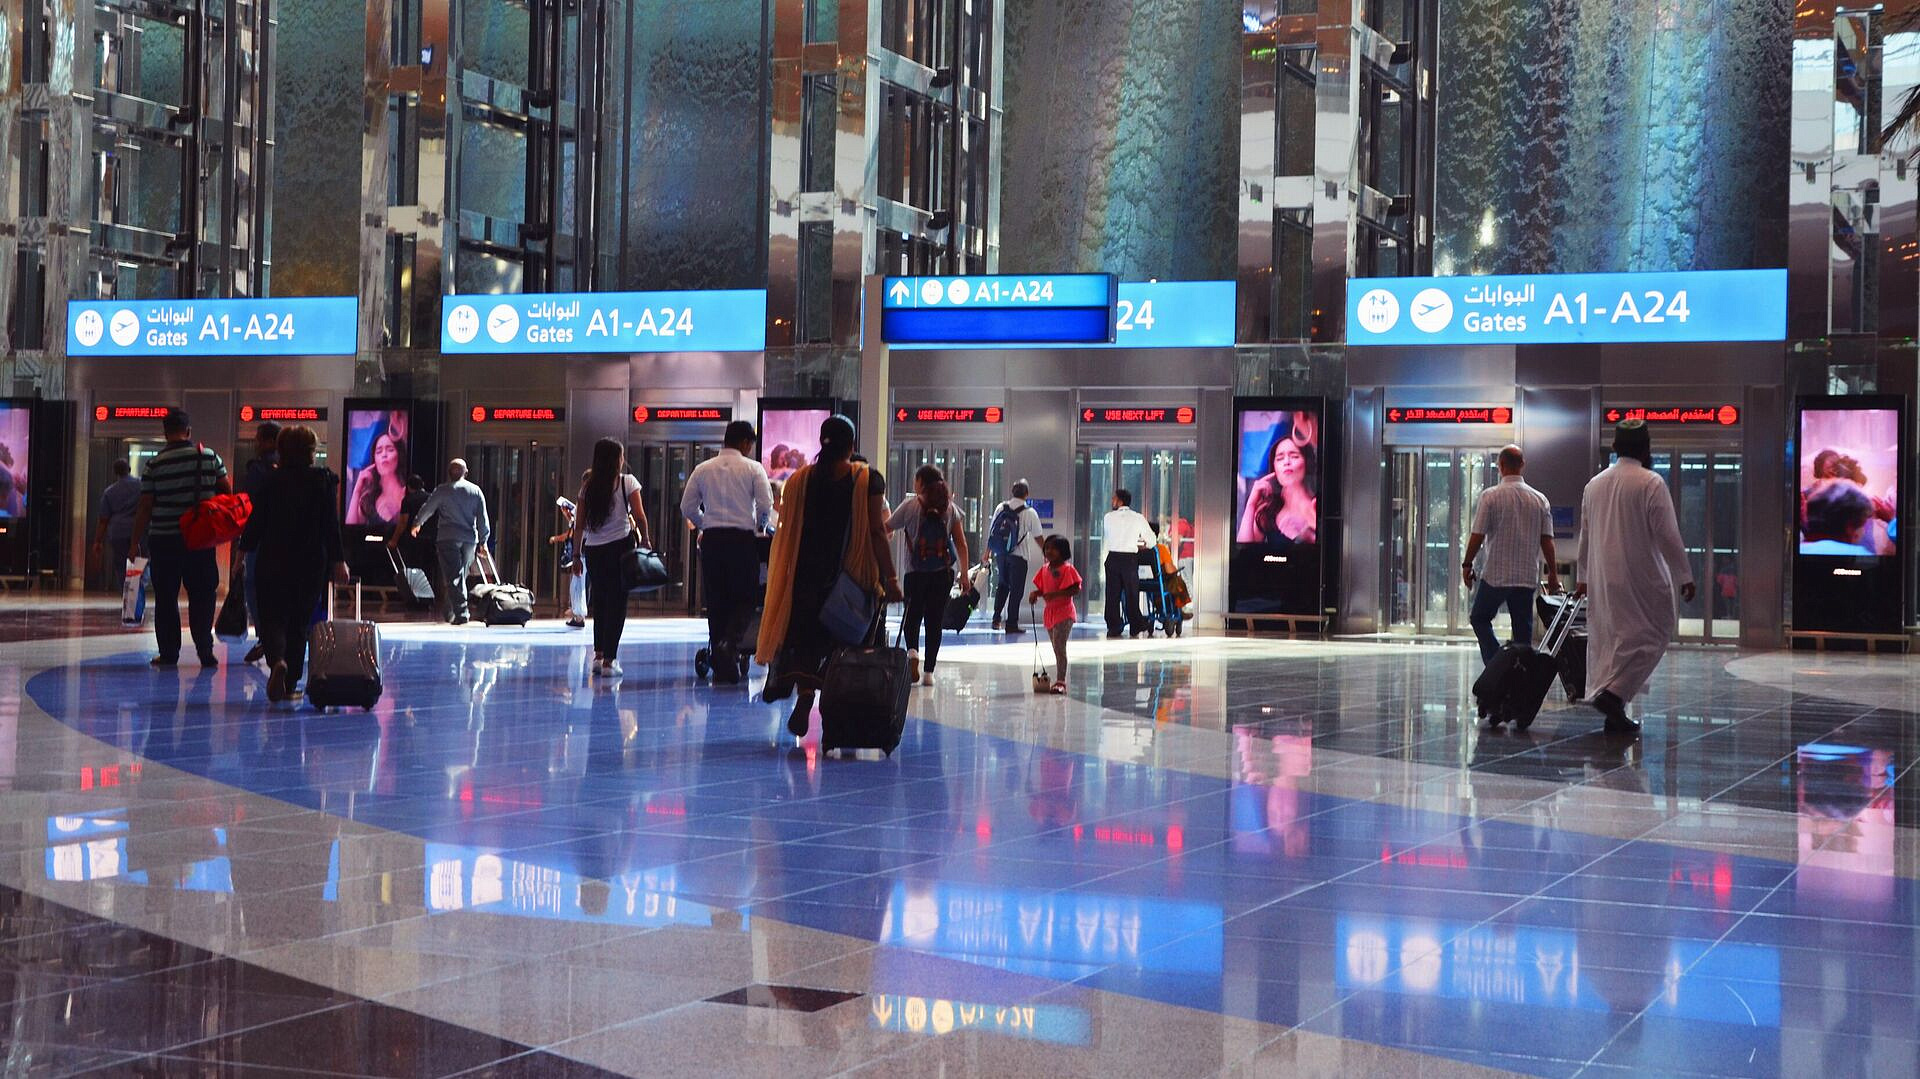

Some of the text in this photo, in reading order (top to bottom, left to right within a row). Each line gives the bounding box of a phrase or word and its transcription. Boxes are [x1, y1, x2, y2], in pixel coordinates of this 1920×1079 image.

[974, 280, 1054, 302] A1-A24
[1463, 283, 1536, 307] البوابات
[146, 306, 194, 326] البوابات
[526, 301, 580, 321] البوابات
[1116, 299, 1155, 331] 24
[1543, 290, 1691, 325] A1-A24
[198, 313, 295, 341] A1-A24
[585, 307, 694, 337] A1-A24
[1463, 311, 1527, 333] Gates
[146, 328, 188, 347] Gates
[526, 324, 574, 343] Gates
[114, 407, 150, 417] DEPARTURE
[260, 409, 318, 419] DEPARTURE LEVEL
[493, 409, 555, 420] DEPARTURE LEVEL
[656, 409, 721, 419] DEPARTURE LEVEL
[917, 409, 975, 420] USE NEXT LIFT
[1104, 409, 1165, 421] USE NEXT LIFT
